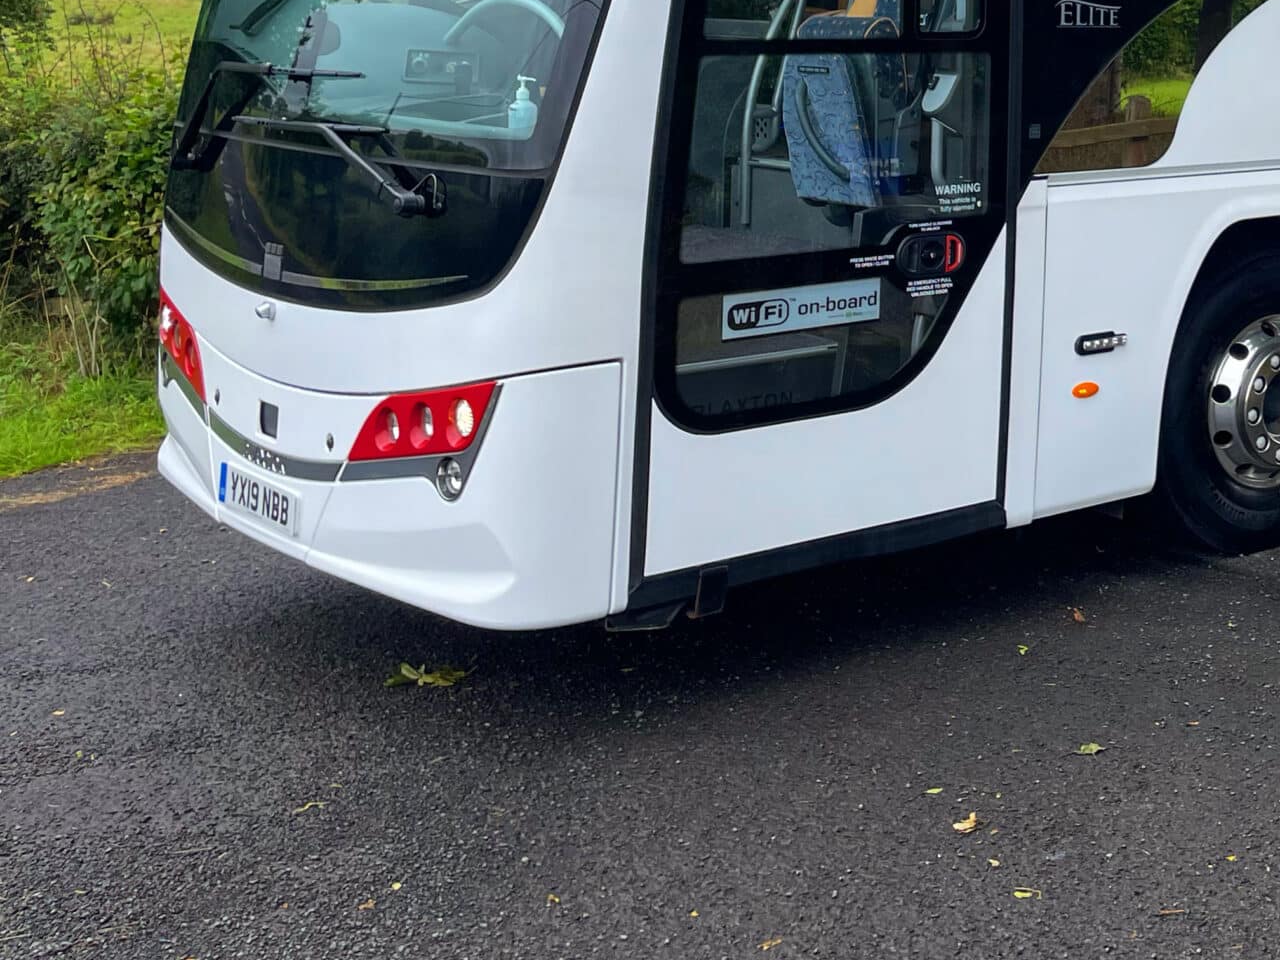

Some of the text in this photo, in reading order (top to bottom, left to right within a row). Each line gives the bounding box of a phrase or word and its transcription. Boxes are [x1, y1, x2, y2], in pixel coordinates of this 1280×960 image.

[1058, 1, 1120, 26] ELITE
[935, 182, 981, 196] WARNING
[798, 290, 878, 315] on-board
[231, 471, 289, 526] YX19 NBB
